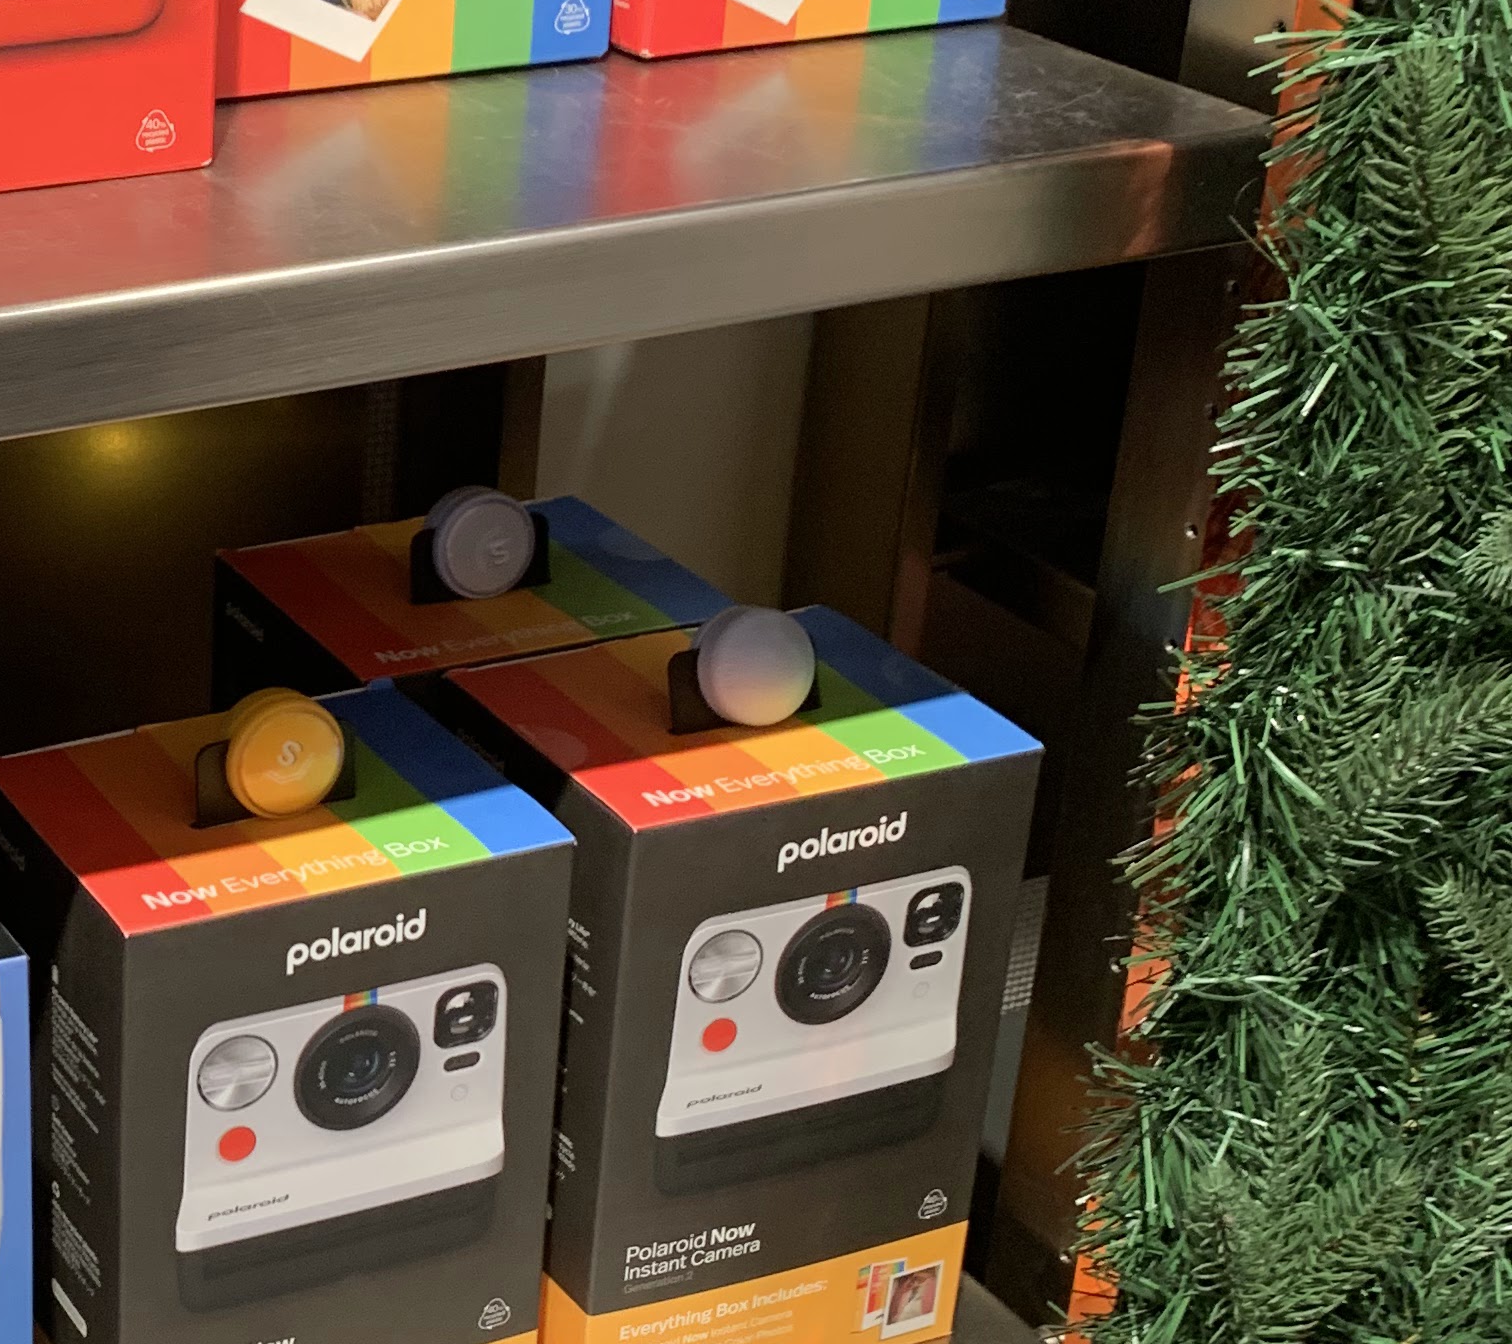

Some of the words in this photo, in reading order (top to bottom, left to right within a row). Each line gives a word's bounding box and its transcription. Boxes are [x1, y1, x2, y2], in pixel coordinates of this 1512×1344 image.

[641, 781, 715, 809] Now
[715, 753, 872, 795] Everything
[863, 741, 926, 766] Box
[141, 879, 217, 910] Now
[221, 849, 388, 895] Everything
[383, 834, 450, 859] Box
[776, 811, 908, 873] polaroid
[285, 907, 428, 975] polaroid
[686, 1084, 762, 1109] polaroid
[206, 1193, 289, 1221] polaroid
[624, 1231, 706, 1265] Polaroid
[710, 1222, 757, 1246] Now
[624, 1254, 687, 1282] Instant
[691, 1239, 761, 1265] Camera
[619, 1306, 712, 1343] Everything
[716, 1297, 749, 1318] Box
[751, 1278, 829, 1307] Includes:
